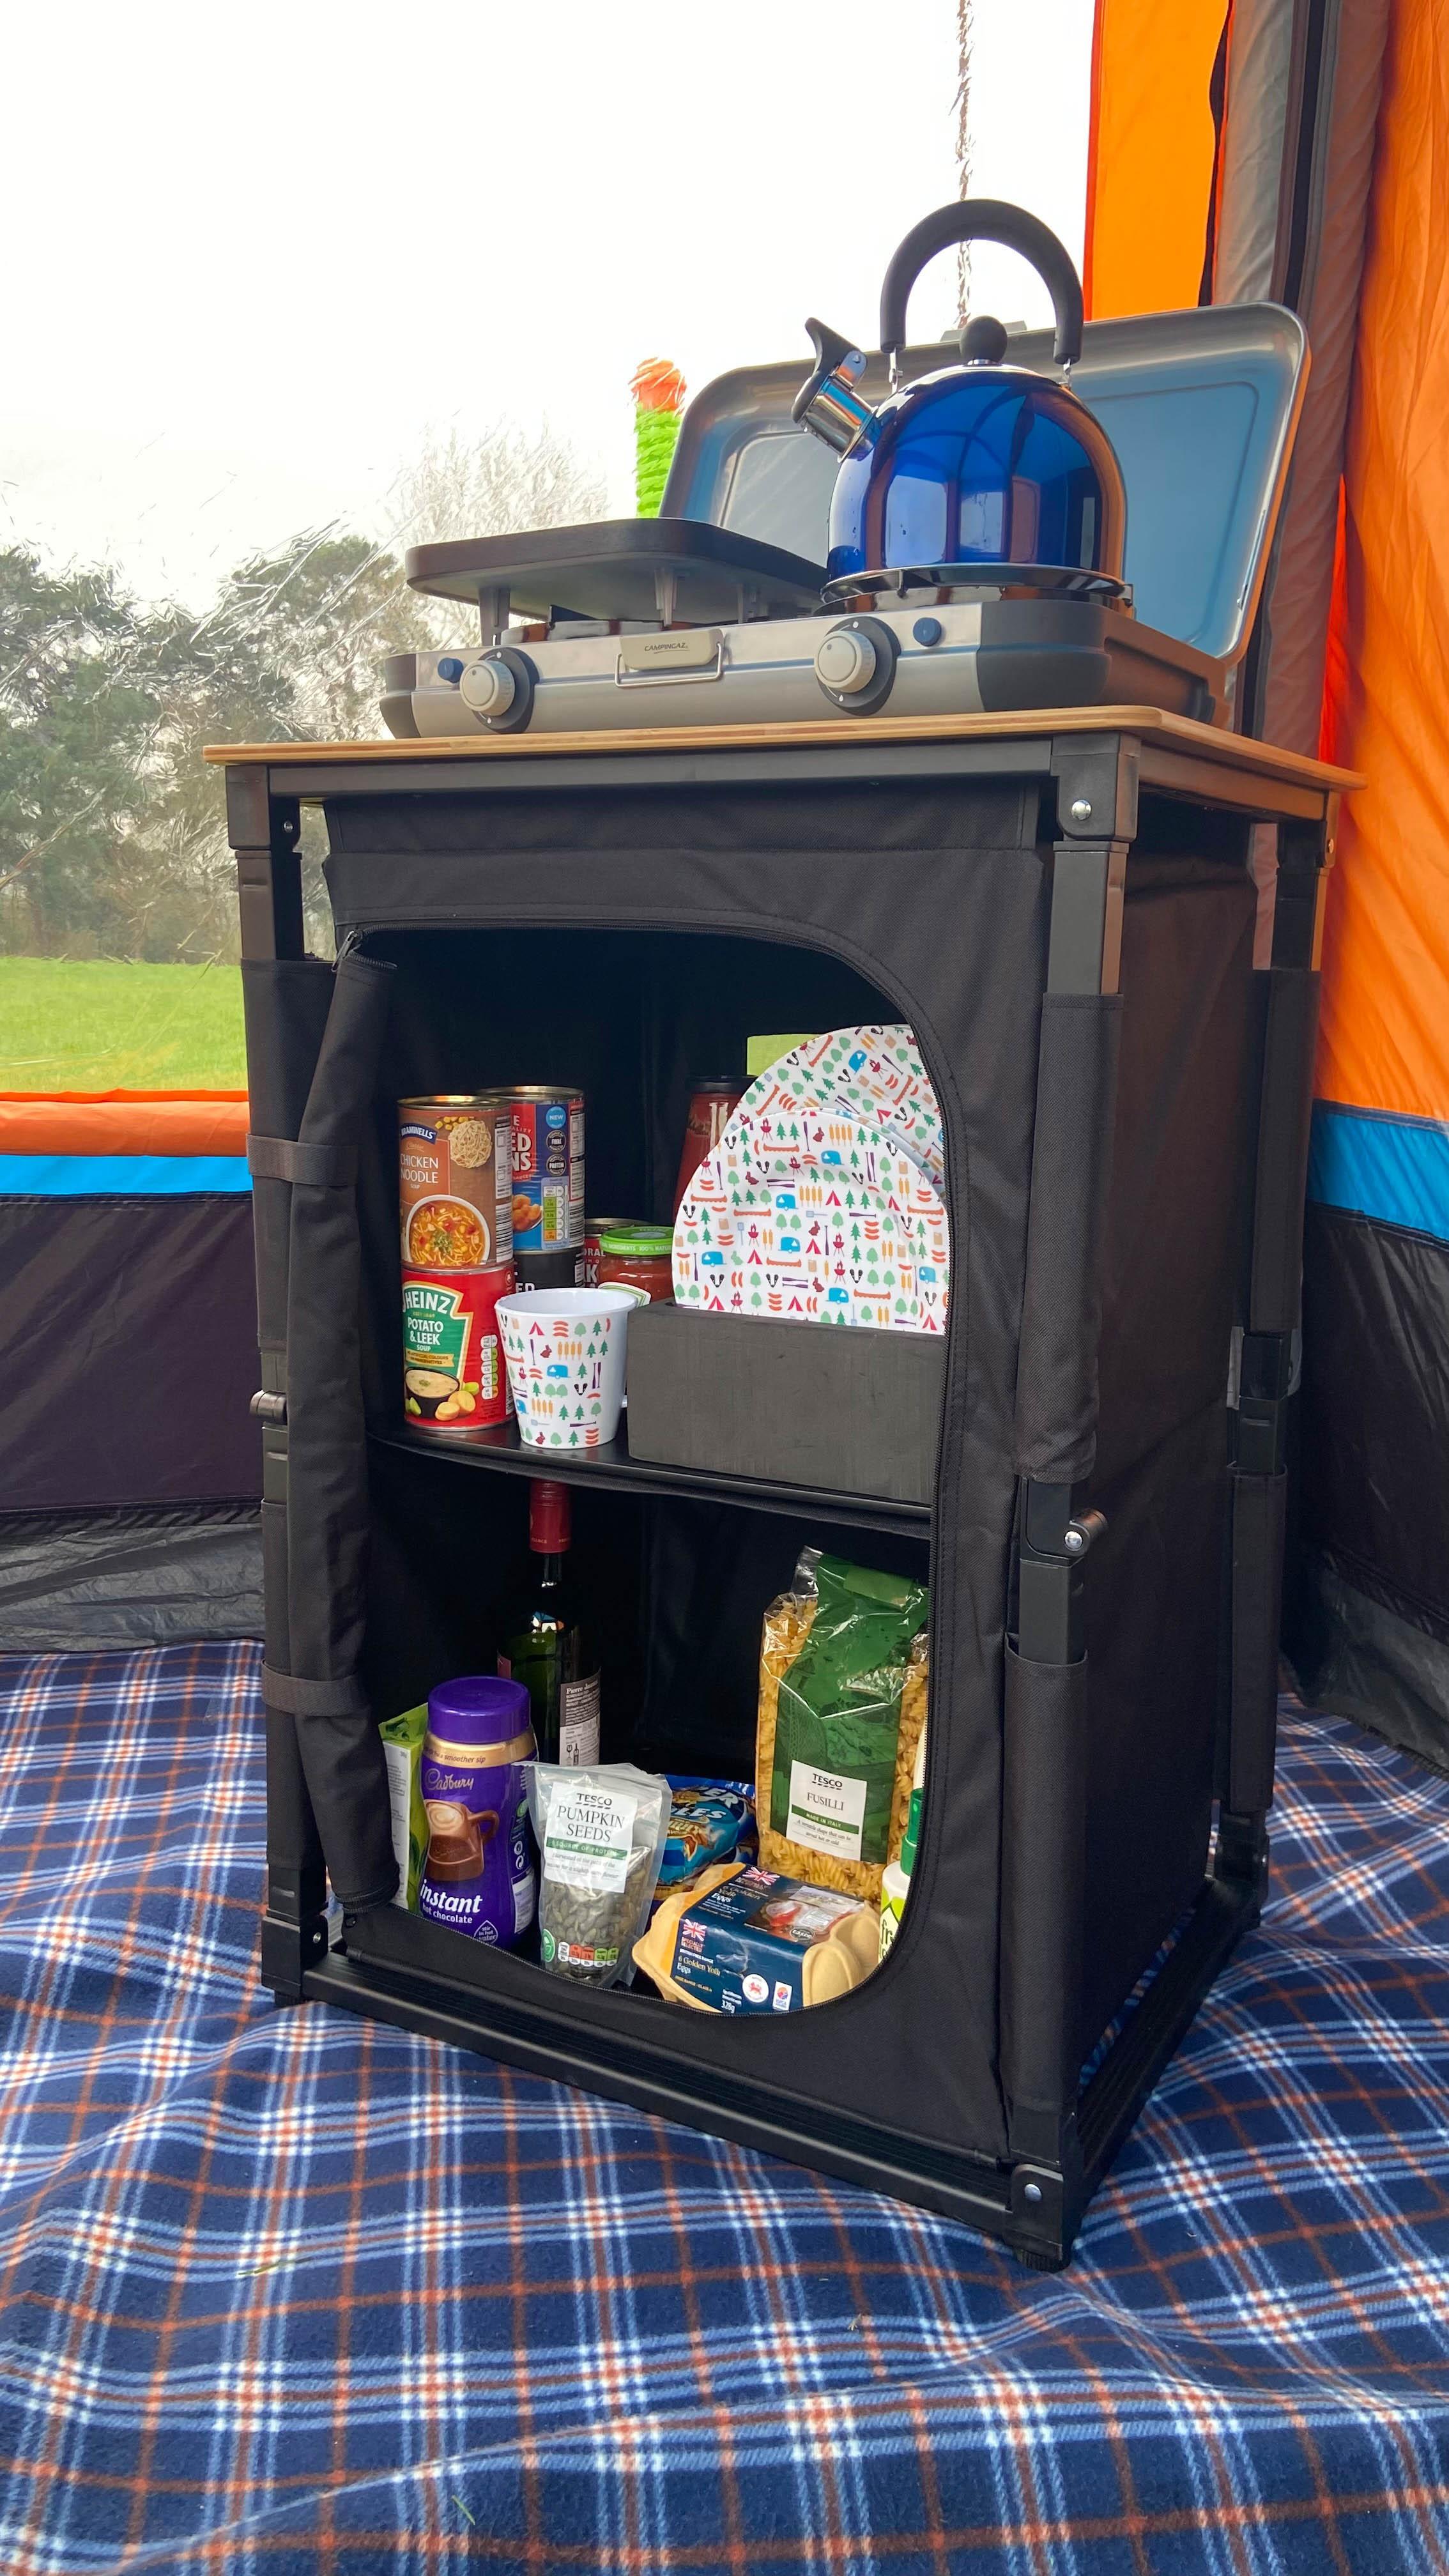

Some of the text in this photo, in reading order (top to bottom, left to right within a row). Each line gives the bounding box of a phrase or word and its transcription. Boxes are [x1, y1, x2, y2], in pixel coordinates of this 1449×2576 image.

[644, 642, 686, 652] CAMPINGAZ
[511, 1125, 532, 1133] ALITY
[400, 1153, 438, 1169] CHICKEN
[400, 1167, 438, 1184] NOODLE
[405, 1291, 451, 1314] HEINZ
[408, 1316, 444, 1333] POTATO
[410, 1330, 441, 1346] & LEEK
[417, 1344, 431, 1352] SOUP
[444, 1754, 475, 1763] smoother
[475, 1755, 486, 1764] sip
[425, 1768, 474, 1791] Cadbury
[813, 1773, 843, 1788] TESCO
[577, 1793, 612, 1806] TESCO
[807, 1791, 844, 1811] FUSILLI
[557, 1805, 625, 1828] PUMPKIN
[806, 1813, 818, 1821] MADE
[567, 1823, 611, 1843] SEEDS
[556, 1840, 579, 1850] SOURCE
[420, 1879, 483, 1913] instant
[711, 1892, 732, 1903] Eggs
[422, 1901, 473, 1924] hot chocolate
[680, 1940, 702, 1952] SELECTED
[681, 1936, 703, 1948] SPECIALLY
[677, 1962, 691, 1975] Eggs
[683, 1957, 706, 1971] Golden
[707, 1965, 721, 1977] Yolk
